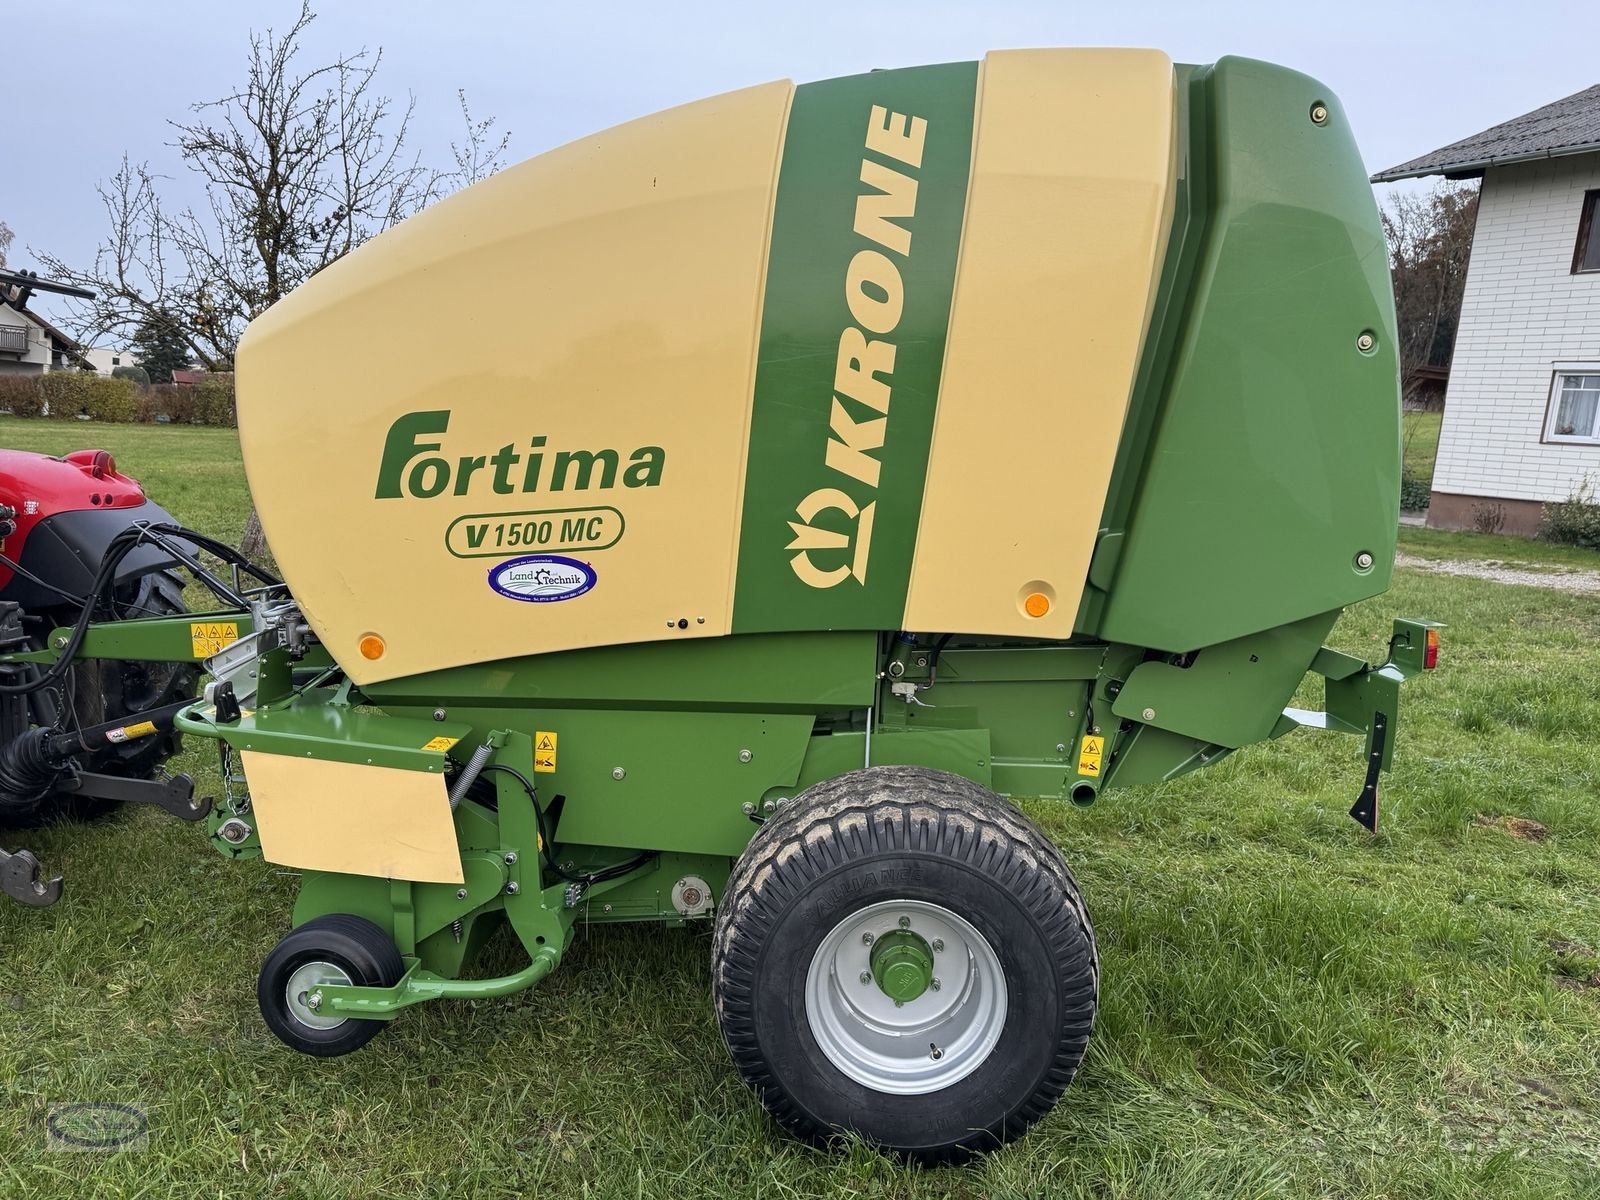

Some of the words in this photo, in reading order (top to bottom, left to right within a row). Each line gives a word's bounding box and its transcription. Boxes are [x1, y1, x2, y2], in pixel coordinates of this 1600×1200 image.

[825, 104, 928, 488] KRONE
[375, 409, 666, 499] Fortima
[466, 524, 489, 548] V
[495, 521, 552, 547] 1500
[560, 516, 603, 543] MC
[509, 571, 533, 581] Land
[543, 575, 581, 585] Technik
[816, 868, 923, 916] ALLIANCE
